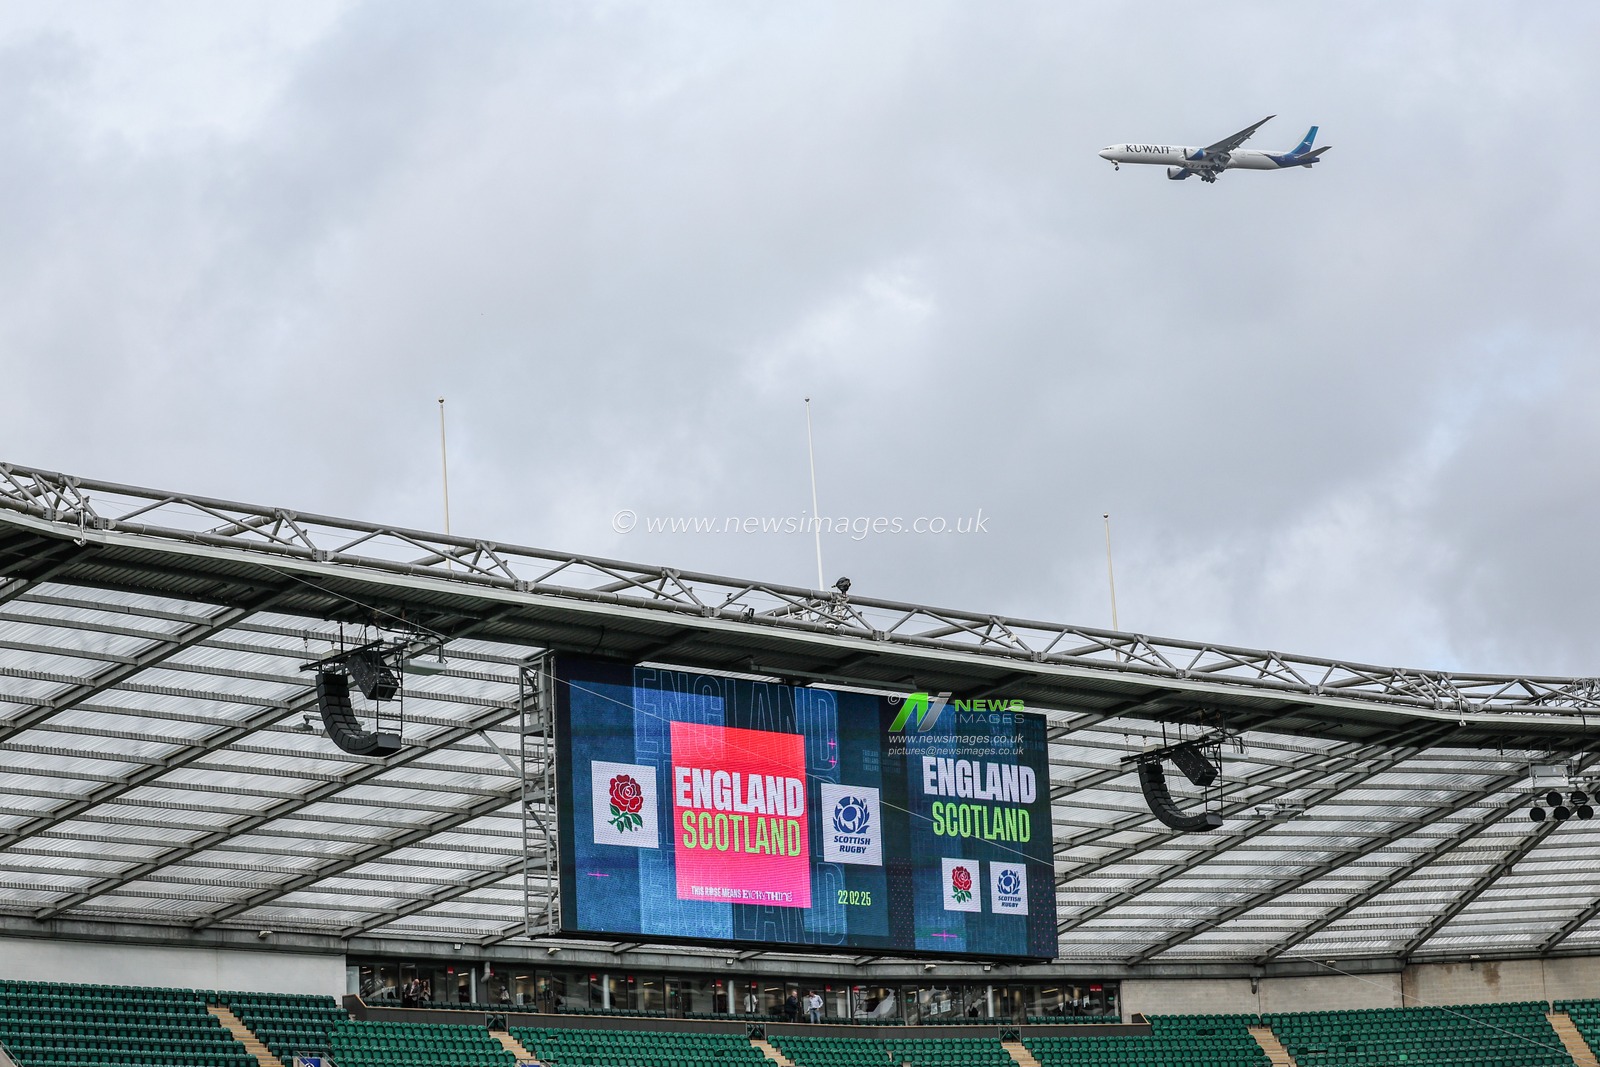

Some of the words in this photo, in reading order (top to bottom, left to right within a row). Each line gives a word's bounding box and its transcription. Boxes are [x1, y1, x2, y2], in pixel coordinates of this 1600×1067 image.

[1126, 145, 1171, 154] KUWAIT
[922, 755, 1037, 804] ENGLAND
[675, 766, 805, 817] ENGLAND
[932, 801, 1031, 843] SCOTLAND
[682, 810, 801, 857] SCOTLAND
[833, 835, 871, 845] SCOTTISH
[839, 845, 867, 854] RUGBY
[691, 885, 704, 896] THIS
[705, 886, 721, 898] ROSE
[722, 888, 741, 899] MEANS
[838, 890, 848, 905] 22
[849, 890, 860, 906] 02
[861, 891, 871, 906] 25
